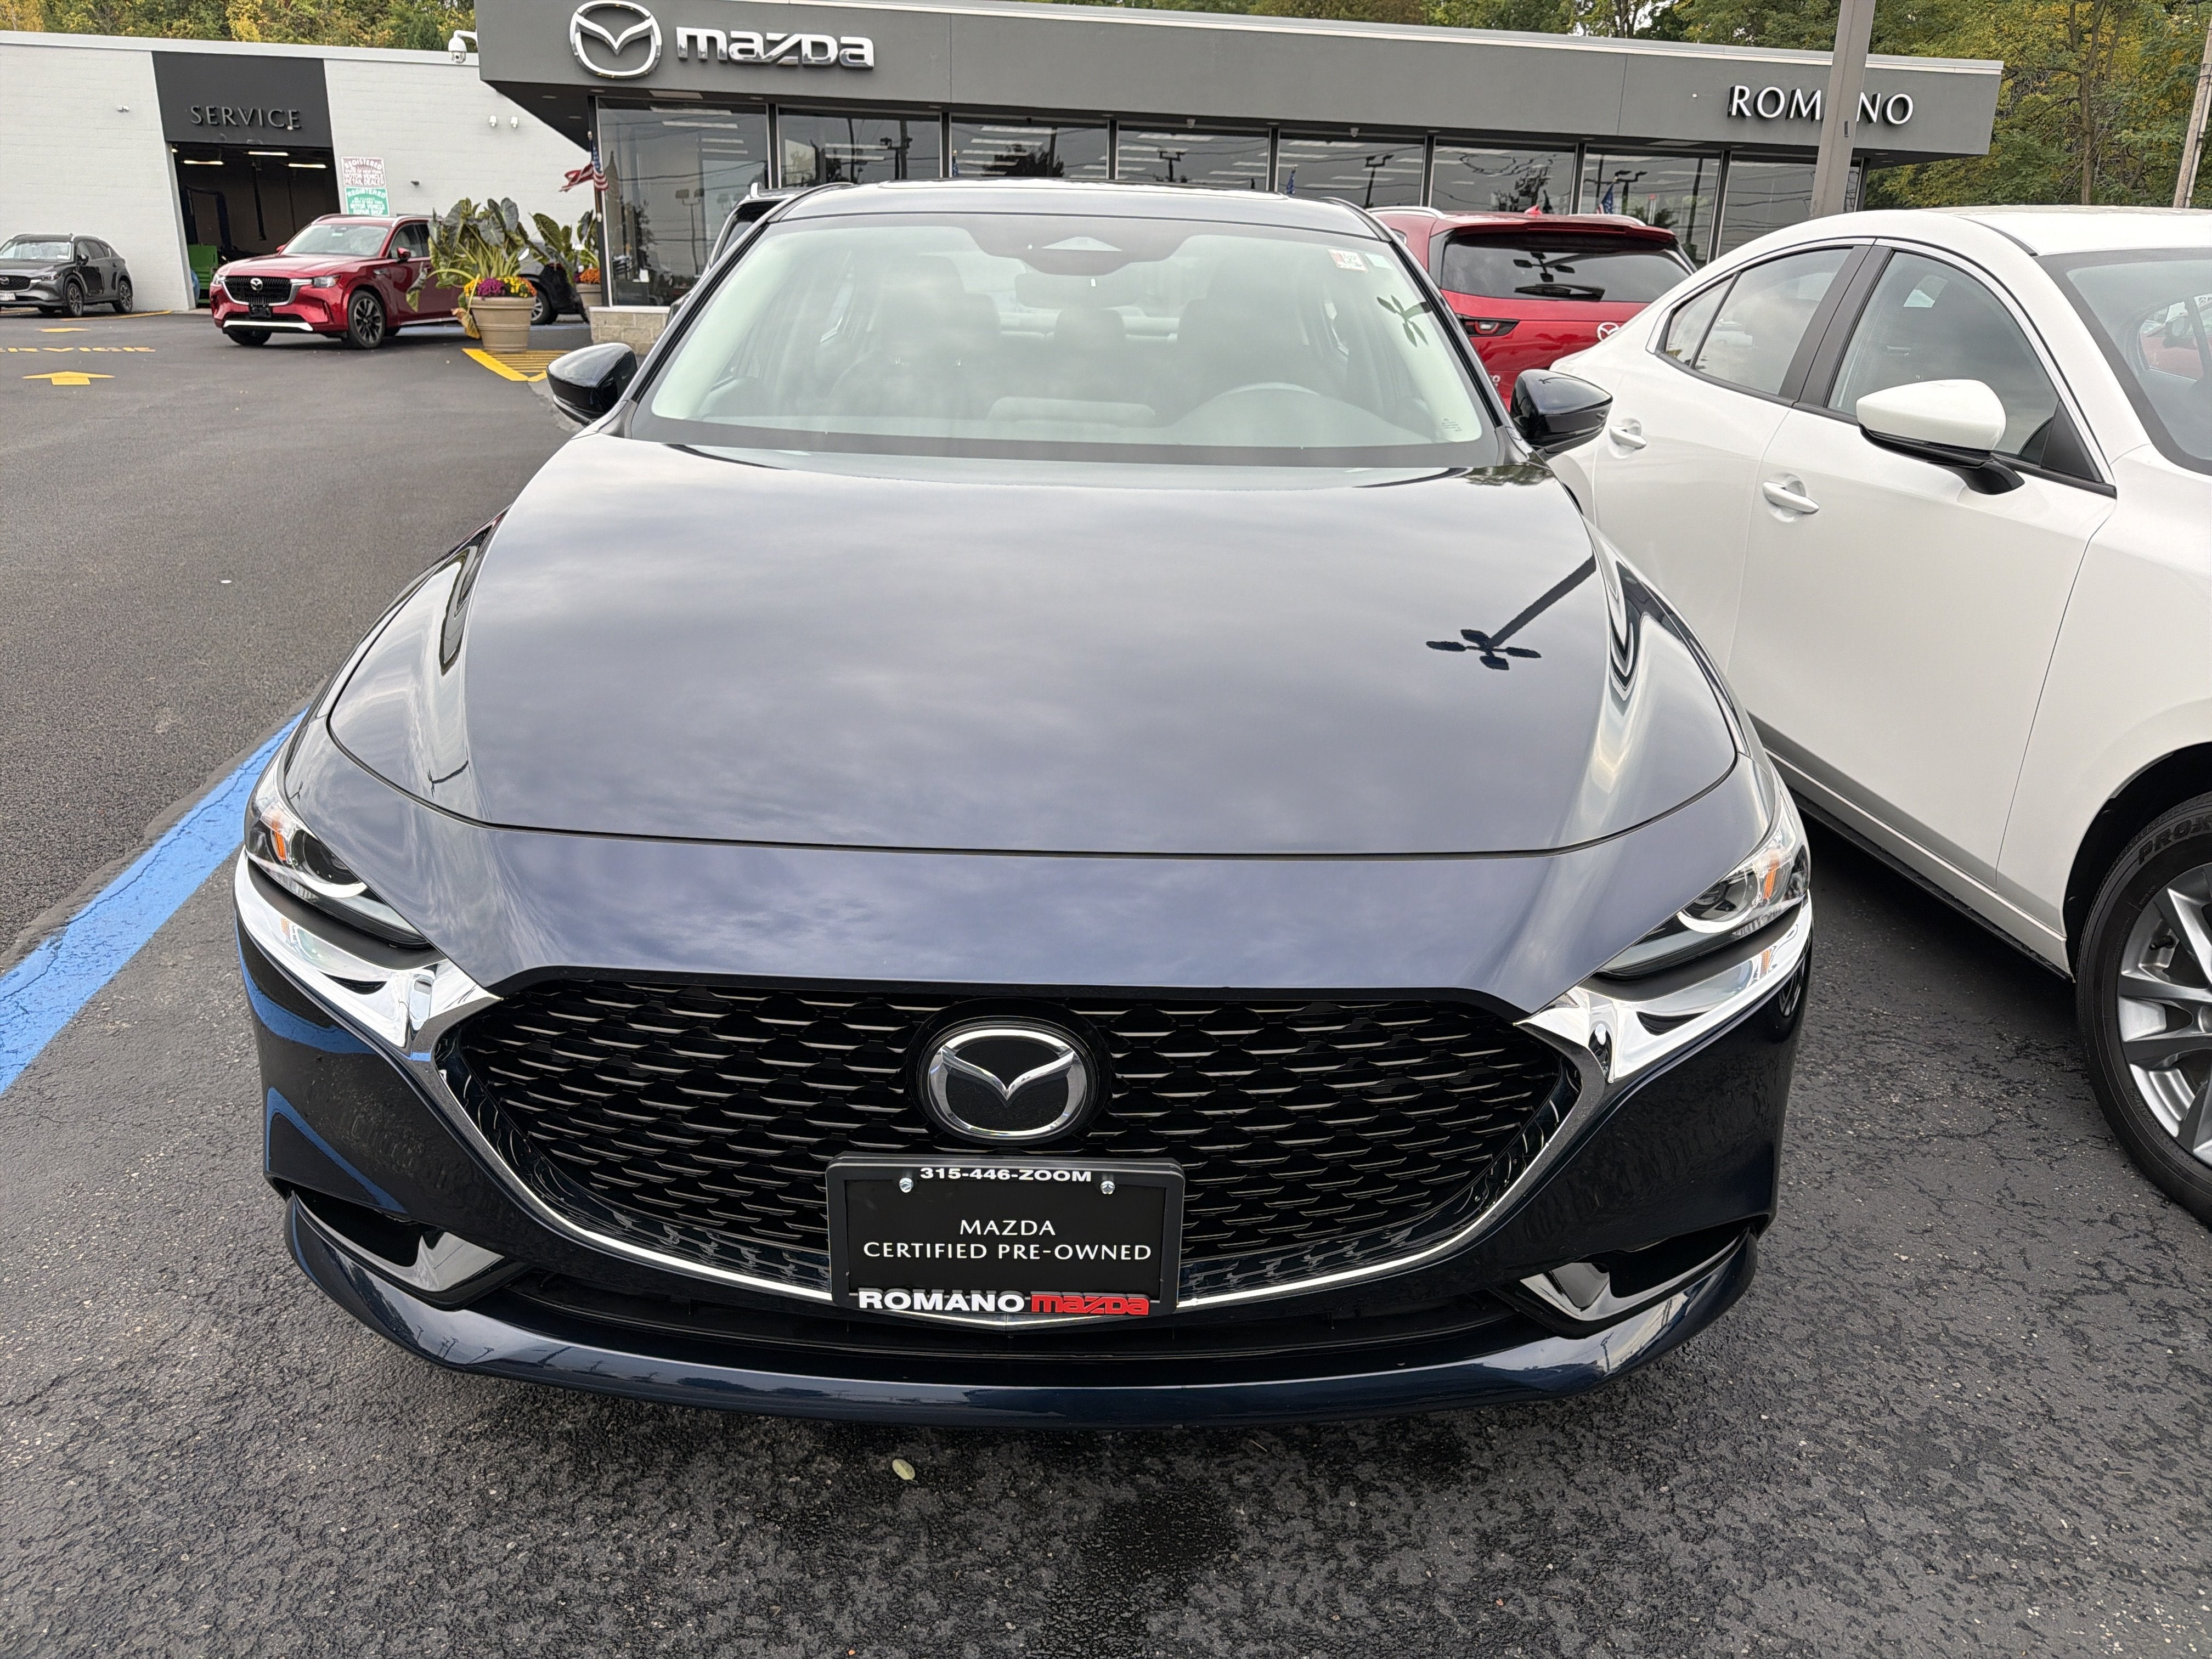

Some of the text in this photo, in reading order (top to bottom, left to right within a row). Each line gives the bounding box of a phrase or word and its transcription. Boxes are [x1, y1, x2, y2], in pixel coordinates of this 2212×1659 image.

[676, 26, 874, 69] mazda
[1729, 85, 1914, 125] ROMNO
[190, 105, 300, 128] SERVICE
[345, 159, 382, 170] REGISTERED
[920, 1167, 1092, 1182] 315-446-ZOOM
[960, 1220, 1056, 1236] MAZDA
[863, 1242, 1152, 1260] CERTIFIED PRE-OWNED
[859, 1289, 1150, 1316] ROMANO mazda
